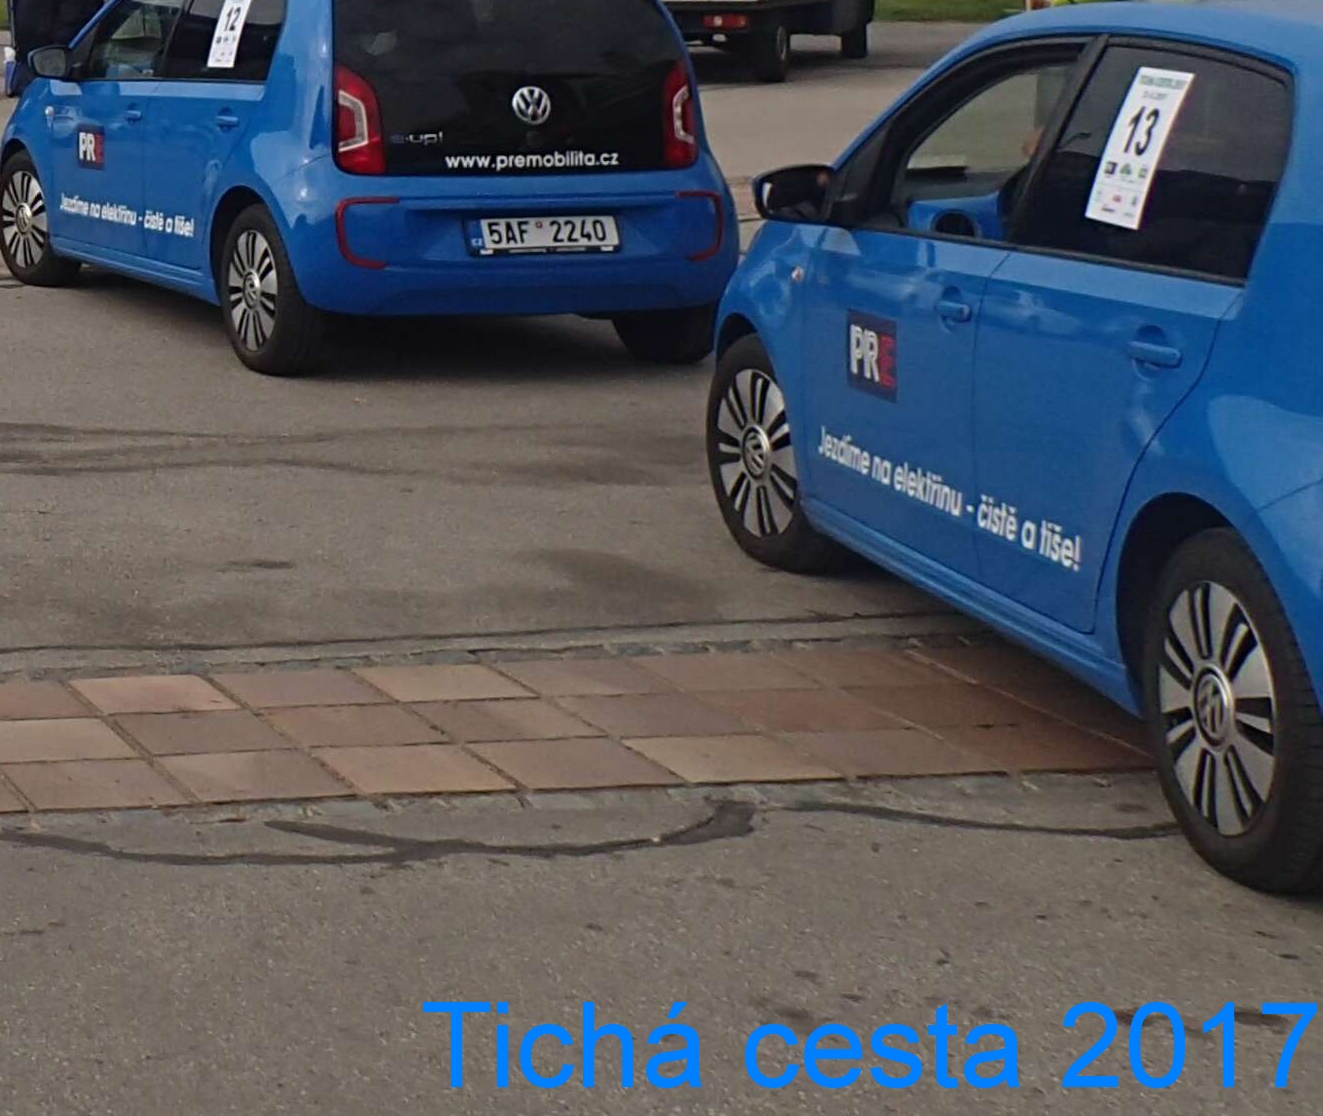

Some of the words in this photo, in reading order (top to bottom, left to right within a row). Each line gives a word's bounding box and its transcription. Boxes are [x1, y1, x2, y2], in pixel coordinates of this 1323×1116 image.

[223, 6, 241, 32] 12
[1124, 105, 1160, 157] 13
[445, 150, 619, 172] www.premobilita.cz
[487, 221, 529, 245] 5AF
[549, 219, 608, 242] 2240
[850, 324, 896, 389] PRE
[819, 425, 870, 474] Jezdíme
[872, 455, 892, 485] na
[893, 462, 963, 517] elektřinu
[976, 494, 1017, 540] čistě
[1021, 520, 1037, 550] a
